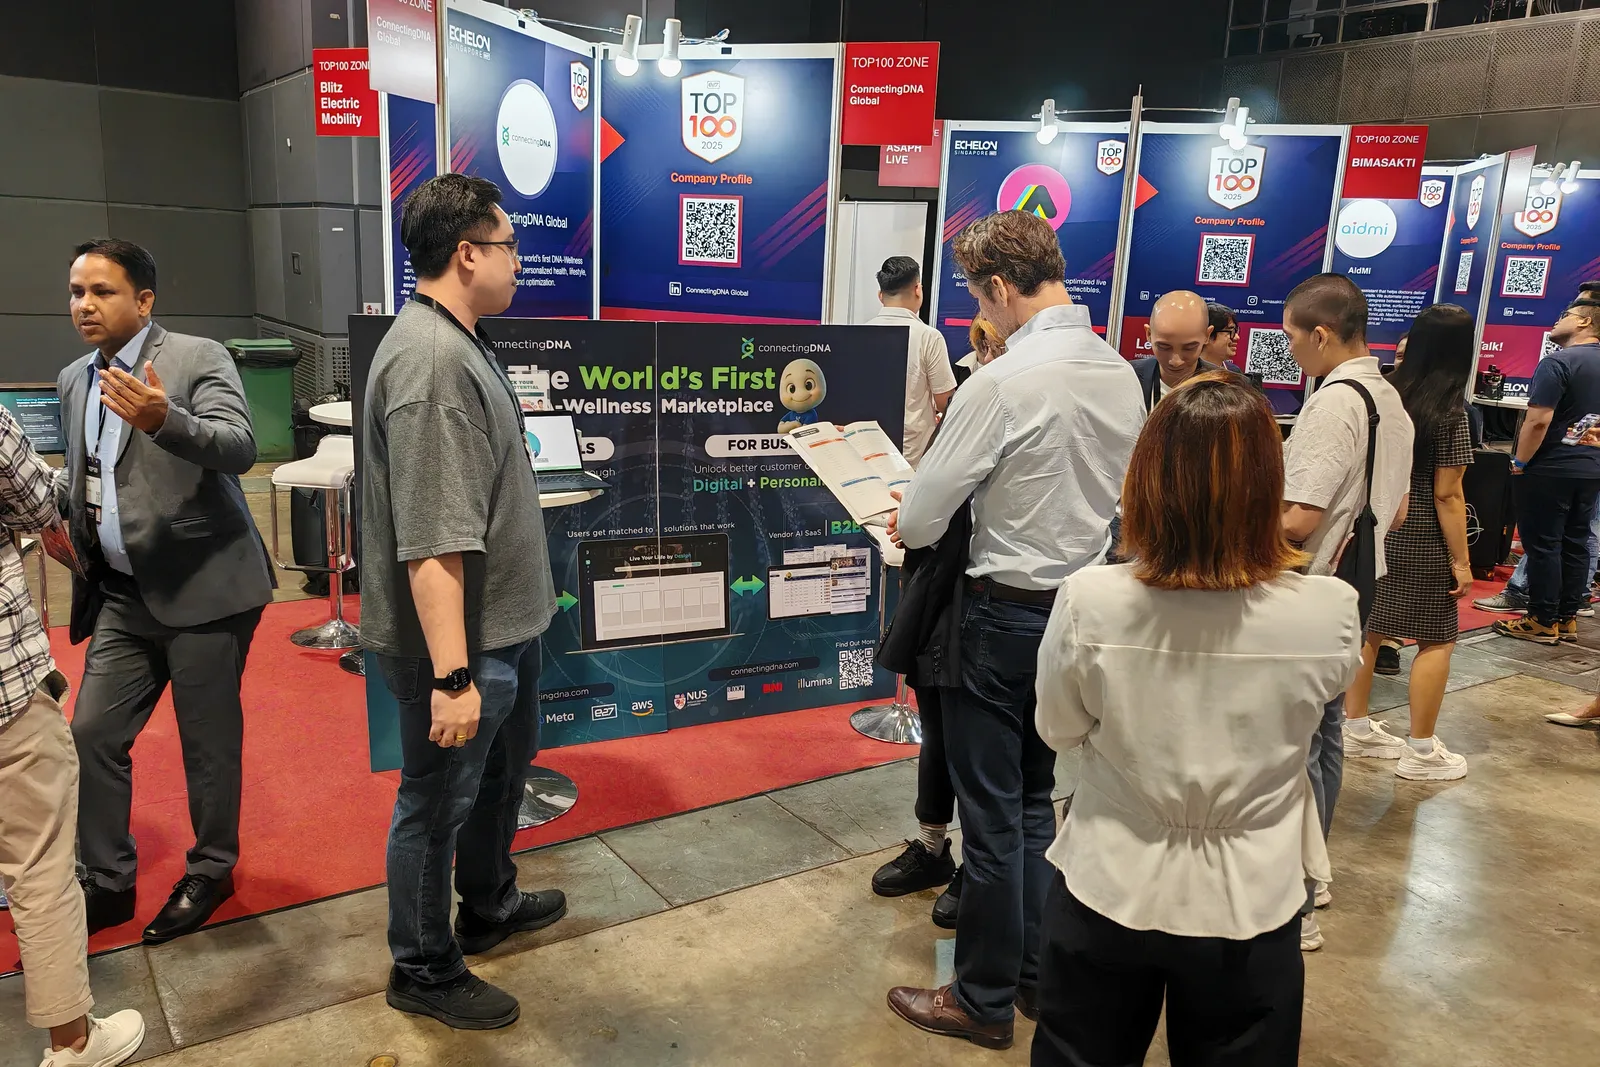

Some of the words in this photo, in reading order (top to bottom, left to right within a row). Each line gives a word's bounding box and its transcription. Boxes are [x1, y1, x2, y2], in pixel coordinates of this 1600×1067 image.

[376, 16, 432, 42] ConnectingDNA
[376, 30, 400, 46] Global
[449, 25, 490, 52] ECHELON
[319, 62, 348, 70] TOP100
[852, 58, 894, 68] TOP100
[896, 57, 929, 68] ZONE
[573, 72, 587, 86] TOP
[320, 82, 343, 93] Blitz
[573, 84, 587, 99] 100
[850, 84, 924, 95] ConnectingDNA
[321, 97, 360, 108] Electric
[690, 93, 737, 114] TOP
[850, 96, 880, 104] Global
[322, 113, 362, 127] Mobility
[689, 116, 736, 138] 100
[955, 140, 998, 150] ECHELON
[1392, 136, 1420, 144] ZONE
[702, 142, 722, 150] 2025
[1102, 148, 1122, 156] TOP
[886, 155, 908, 164] LIVE
[1100, 157, 1121, 166] 100
[1352, 158, 1416, 168] BIMASAKTI
[1217, 158, 1257, 174] TOP
[671, 172, 717, 185] Company
[720, 174, 752, 184] Profile
[1214, 174, 1255, 192] 100
[1424, 186, 1442, 194] TOP
[546, 215, 568, 228] Global
[1195, 216, 1235, 226] Company
[1237, 218, 1266, 226] Profile
[1342, 222, 1388, 236] aidmi
[686, 286, 730, 296] ConnectingDNA
[758, 344, 831, 354] connectingDNA
[712, 366, 776, 390] First
[662, 398, 774, 416] Marketplace
[728, 440, 757, 450] FOR
[694, 465, 727, 474] Unlock
[730, 464, 758, 472] better
[760, 462, 802, 472] customer
[694, 477, 742, 494] Digital
[592, 529, 606, 538] get
[609, 526, 642, 535] matched
[664, 524, 698, 532] solutions
[768, 530, 793, 538] Vendor
[730, 661, 799, 676] connectingdna.com
[798, 677, 832, 690] illumina
[687, 690, 708, 700] NUS
[632, 700, 653, 710] aws
[546, 712, 574, 724] Meta
